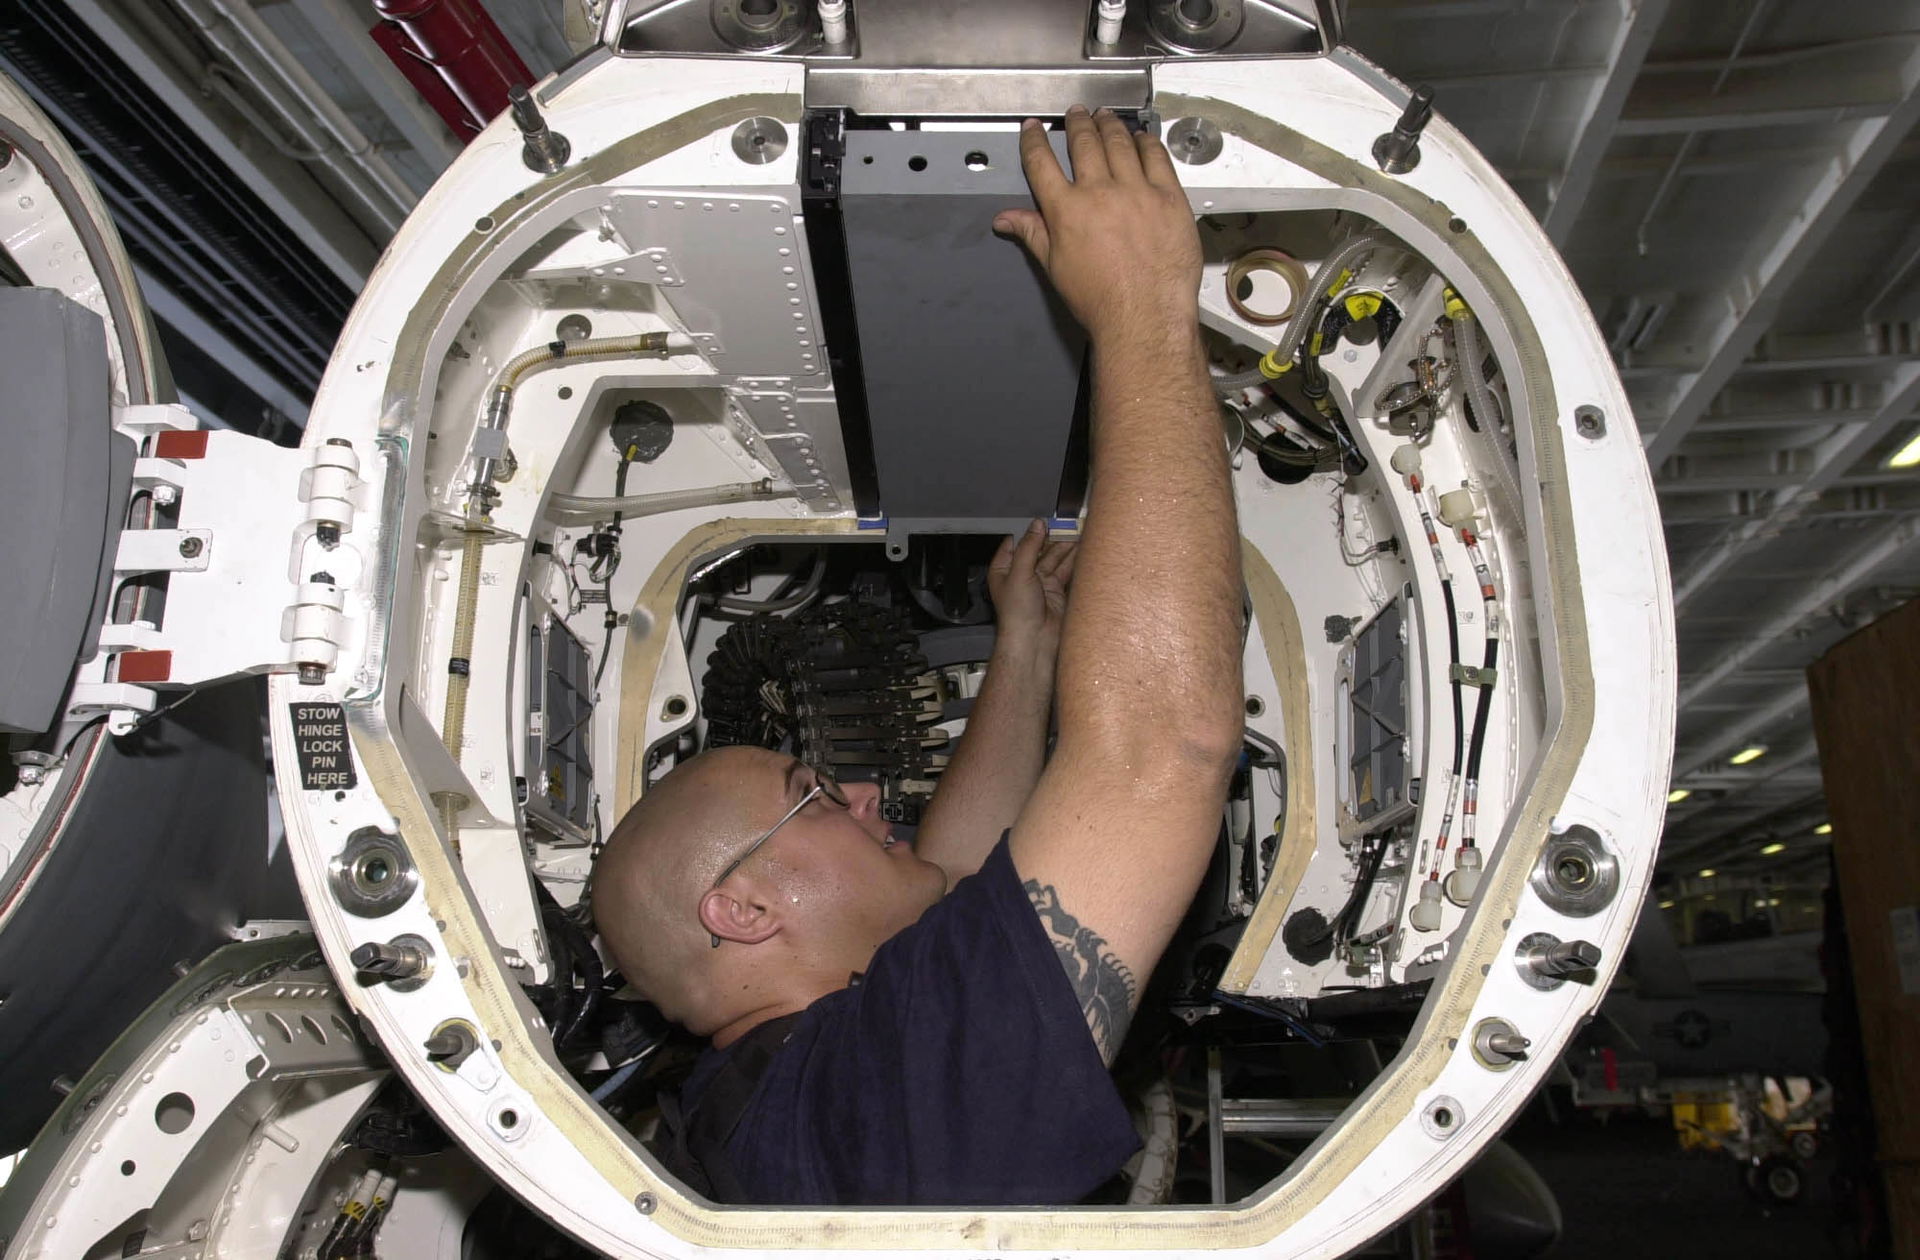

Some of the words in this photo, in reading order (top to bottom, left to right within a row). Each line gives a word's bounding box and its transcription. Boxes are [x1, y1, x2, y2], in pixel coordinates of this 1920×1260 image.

[298, 708, 340, 720] STOW
[298, 724, 342, 736] HINGE
[303, 741, 342, 752] LOCK
[312, 756, 336, 768] PIN
[307, 772, 348, 784] HERE
